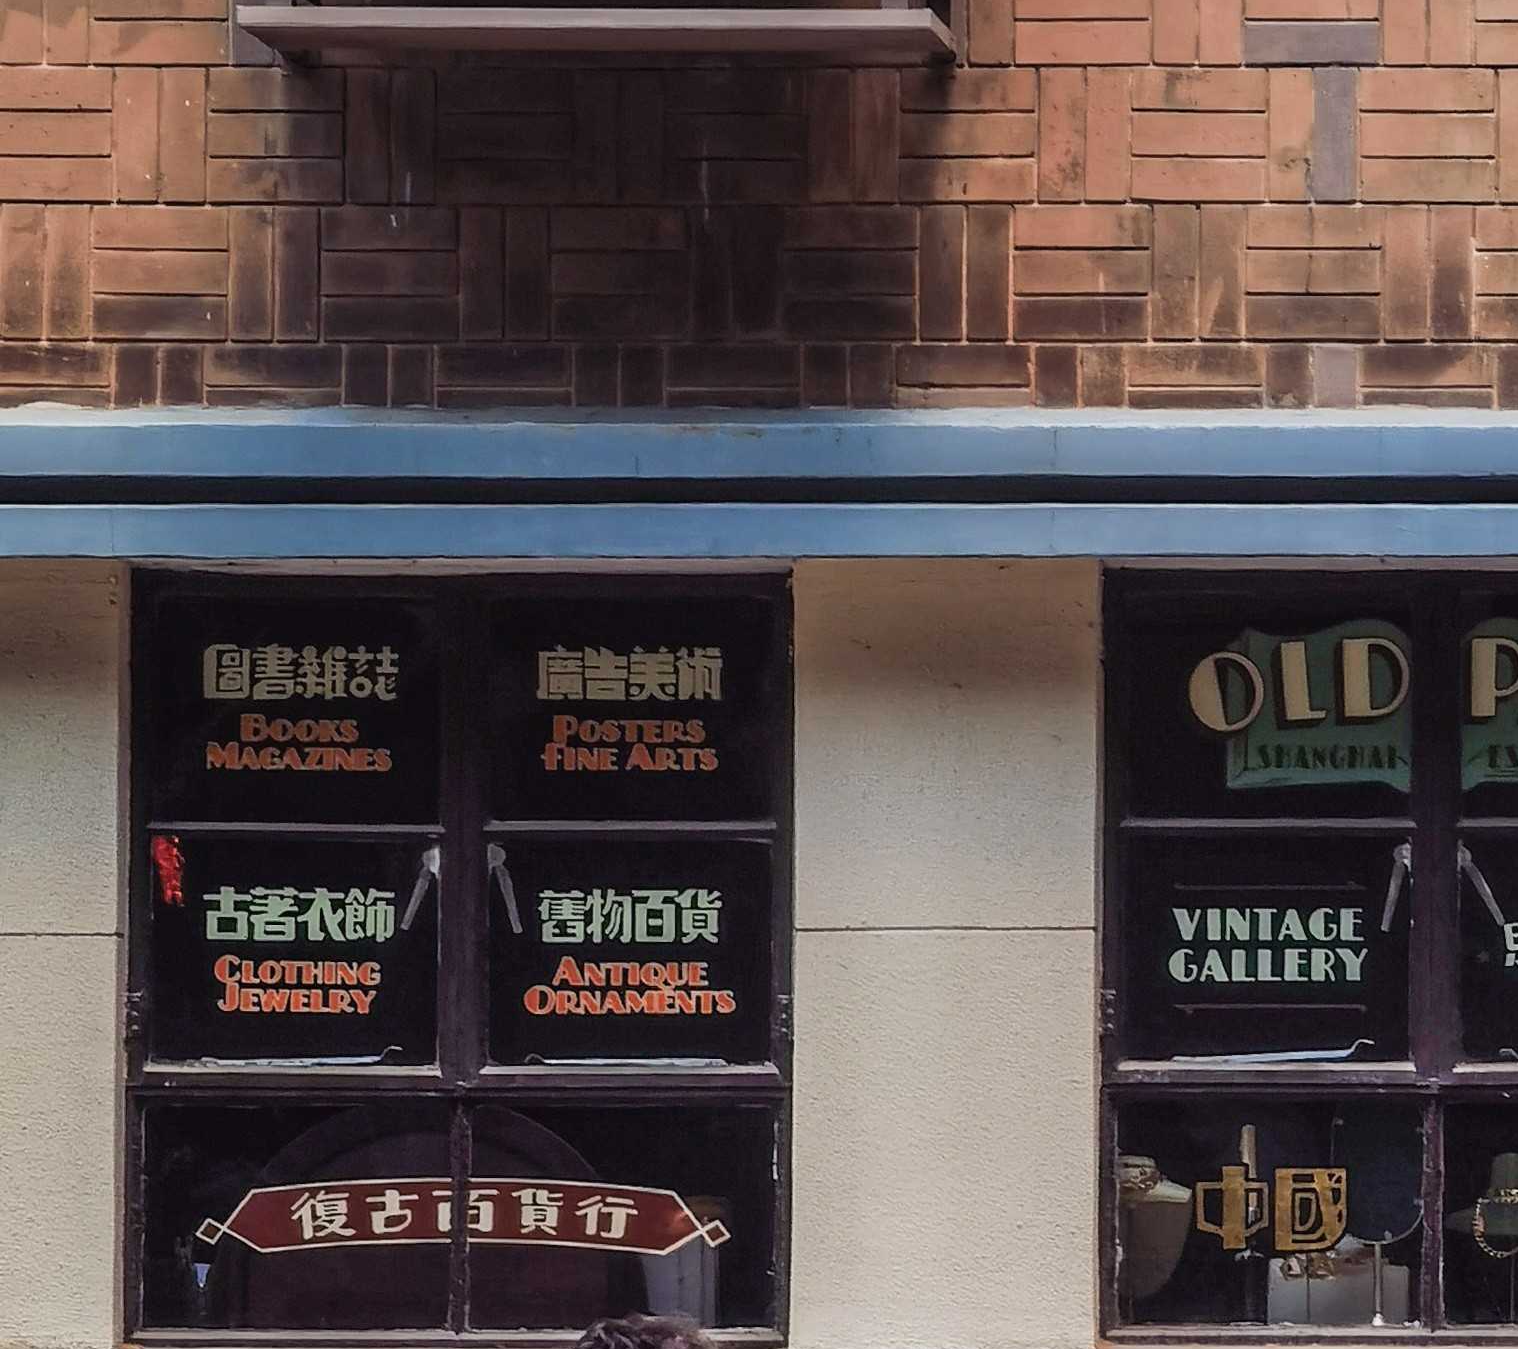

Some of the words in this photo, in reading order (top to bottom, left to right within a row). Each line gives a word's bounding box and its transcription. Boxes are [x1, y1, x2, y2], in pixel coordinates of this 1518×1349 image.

[202, 643, 399, 701] 圖書雜誌
[536, 643, 723, 701] 廣告美術
[1188, 637, 1410, 732] OLD
[239, 713, 360, 743] BOOKS
[552, 714, 707, 744] POSTERS
[205, 741, 393, 772] MAGAZINES
[539, 742, 619, 771] FINE
[624, 742, 720, 771] ARTS
[202, 886, 396, 943] 古著衣飾
[537, 888, 723, 944] 舊物百貨
[1171, 907, 1365, 941] VINTAGE
[213, 953, 383, 986] CLOTHING
[551, 955, 710, 989] ANTIQUE
[1167, 947, 1369, 983] GALLERY
[216, 982, 377, 1015] JEWELRY
[523, 984, 737, 1015] ORNAMENTS
[289, 1187, 639, 1240] 復古百貨行
[1195, 1165, 1347, 1251] 中國
